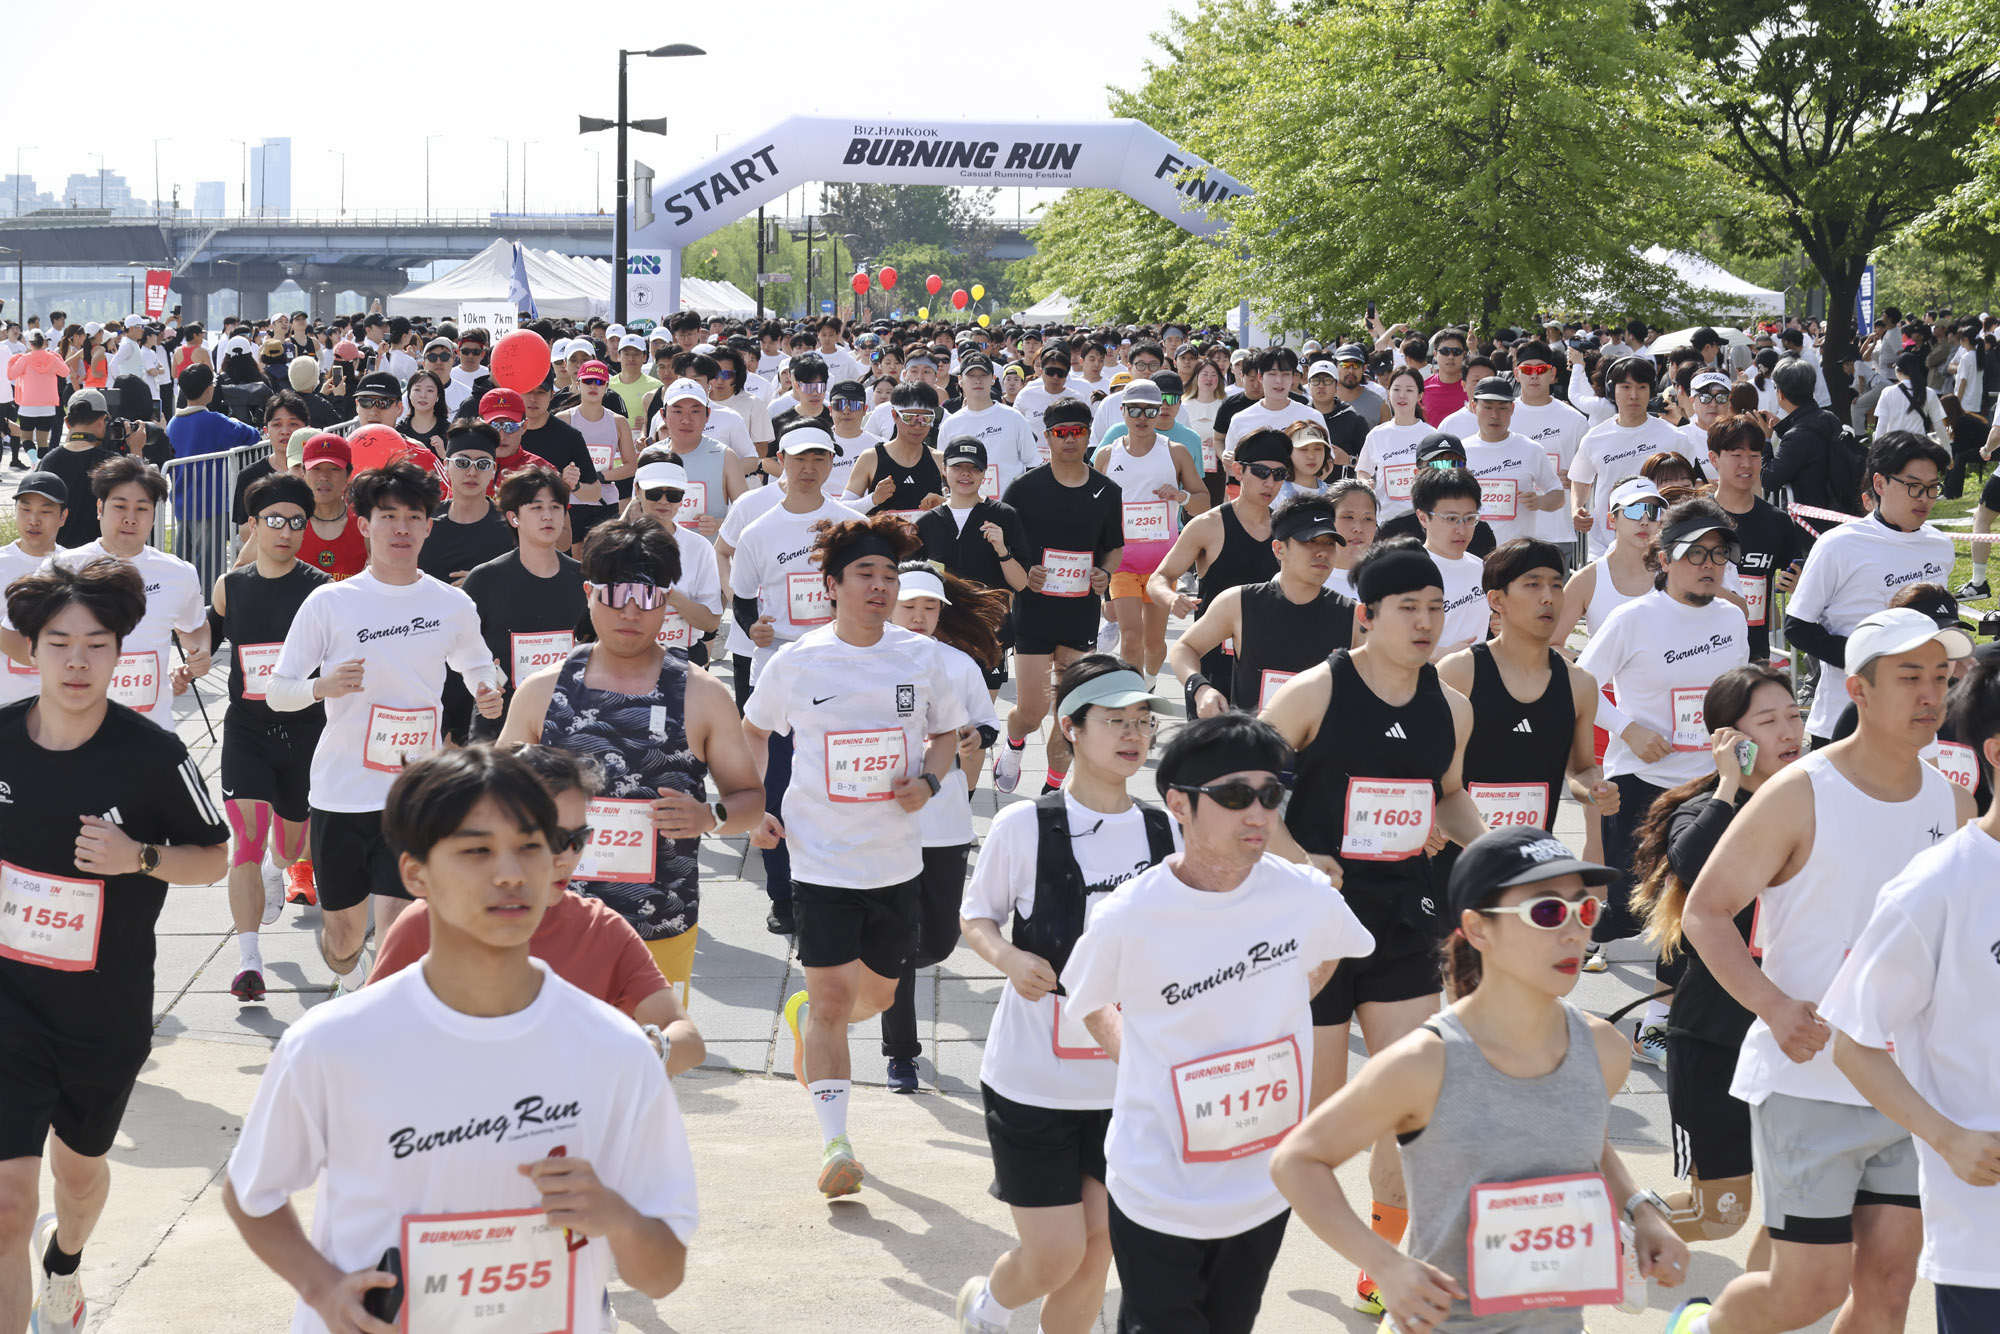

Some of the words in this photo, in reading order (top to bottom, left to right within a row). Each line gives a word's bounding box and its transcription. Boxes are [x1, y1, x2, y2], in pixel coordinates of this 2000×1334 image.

[843, 138, 999, 168] BURNING
[1004, 142, 1082, 170] RUN
[960, 170, 992, 178] Casual
[994, 171, 1033, 179] Running
[1035, 171, 1072, 179] Festival
[1154, 153, 1241, 204] FINI
[664, 144, 780, 227] START
[463, 313, 486, 324] 10km
[494, 313, 513, 324] 7km
[986, 426, 1002, 436] Run
[1543, 428, 1561, 436] Run
[1383, 447, 1409, 461] Burning
[1603, 450, 1636, 464] Burning
[1637, 443, 1657, 454] Run
[1503, 459, 1522, 468] Run
[1482, 494, 1511, 503] 2202
[1135, 516, 1162, 526] 2361
[1056, 568, 1087, 578] 2161
[1884, 570, 1923, 587] Burning
[1923, 562, 1942, 576] Run
[1443, 594, 1474, 613] Burning
[357, 623, 410, 643] Burning
[411, 617, 441, 632] Run
[1663, 642, 1711, 664] Burning
[1710, 634, 1733, 648] Run
[520, 655, 530, 664] M
[248, 667, 256, 675] M
[111, 674, 153, 688] 1618
[377, 712, 405, 721] BURNING
[1681, 713, 1691, 722] M
[376, 732, 387, 742] M
[390, 731, 428, 746] 1337
[832, 738, 863, 746] BURNING
[835, 760, 847, 771] M
[852, 754, 900, 772] 1257
[837, 782, 857, 792] B-76
[1356, 786, 1391, 795] BURNING
[602, 806, 621, 814] RUN
[1356, 810, 1369, 822] M
[1372, 809, 1422, 826] 1603
[1490, 811, 1539, 826] 2190
[1351, 838, 1372, 847] B-75
[12, 880, 41, 892] A-208
[72, 889, 94, 898] 10km
[3, 901, 18, 916] M
[22, 905, 85, 932] 1554
[1161, 960, 1248, 1006] Burning
[1247, 938, 1299, 969] Run
[1184, 1062, 1231, 1082] BURNING
[1233, 1057, 1256, 1071] RUN
[1266, 1049, 1290, 1062] 10km
[1195, 1101, 1213, 1119] M
[1219, 1079, 1288, 1117] 1176
[388, 1115, 511, 1159] Burning
[514, 1095, 581, 1129] Run
[1487, 1194, 1539, 1210] BURNING
[1541, 1191, 1566, 1203] RUN
[419, 1228, 483, 1244] BURNING
[485, 1226, 517, 1239] RUN
[1486, 1233, 1507, 1250] W
[1510, 1222, 1594, 1253] 3581
[424, 1274, 448, 1295] M
[457, 1259, 552, 1297] 1555
